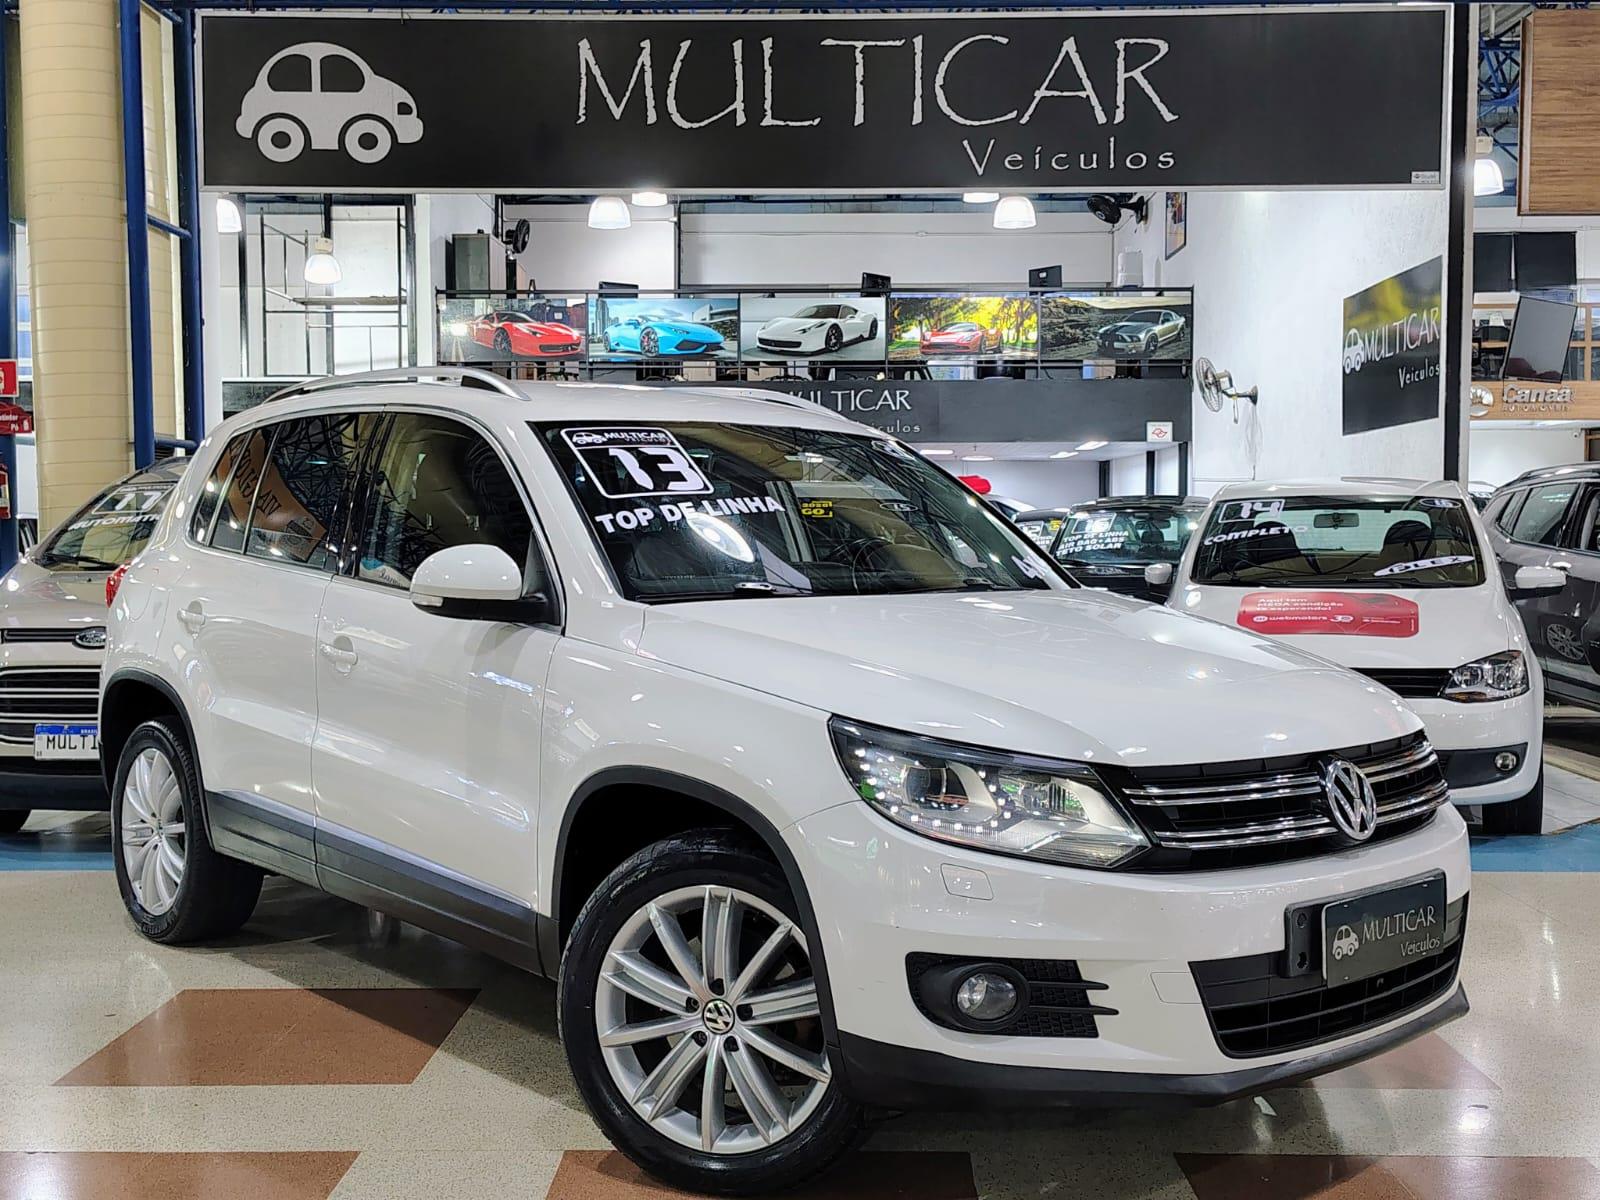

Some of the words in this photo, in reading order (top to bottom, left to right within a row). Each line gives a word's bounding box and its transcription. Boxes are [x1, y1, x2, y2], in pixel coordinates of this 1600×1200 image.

[576, 34, 1180, 129] MULTICAR
[1364, 307, 1440, 363] MULTICAR
[608, 447, 705, 491] 13
[595, 507, 655, 534] TOP
[659, 502, 698, 523] DE
[701, 496, 786, 517] LINHA
[1240, 501, 1281, 519] 14
[1063, 534, 1082, 542] TOP
[1098, 530, 1129, 538] LINHA
[1084, 542, 1122, 551] SOLAR
[1204, 525, 1309, 546] COMPLETO
[1362, 905, 1436, 945] MULTICAR
